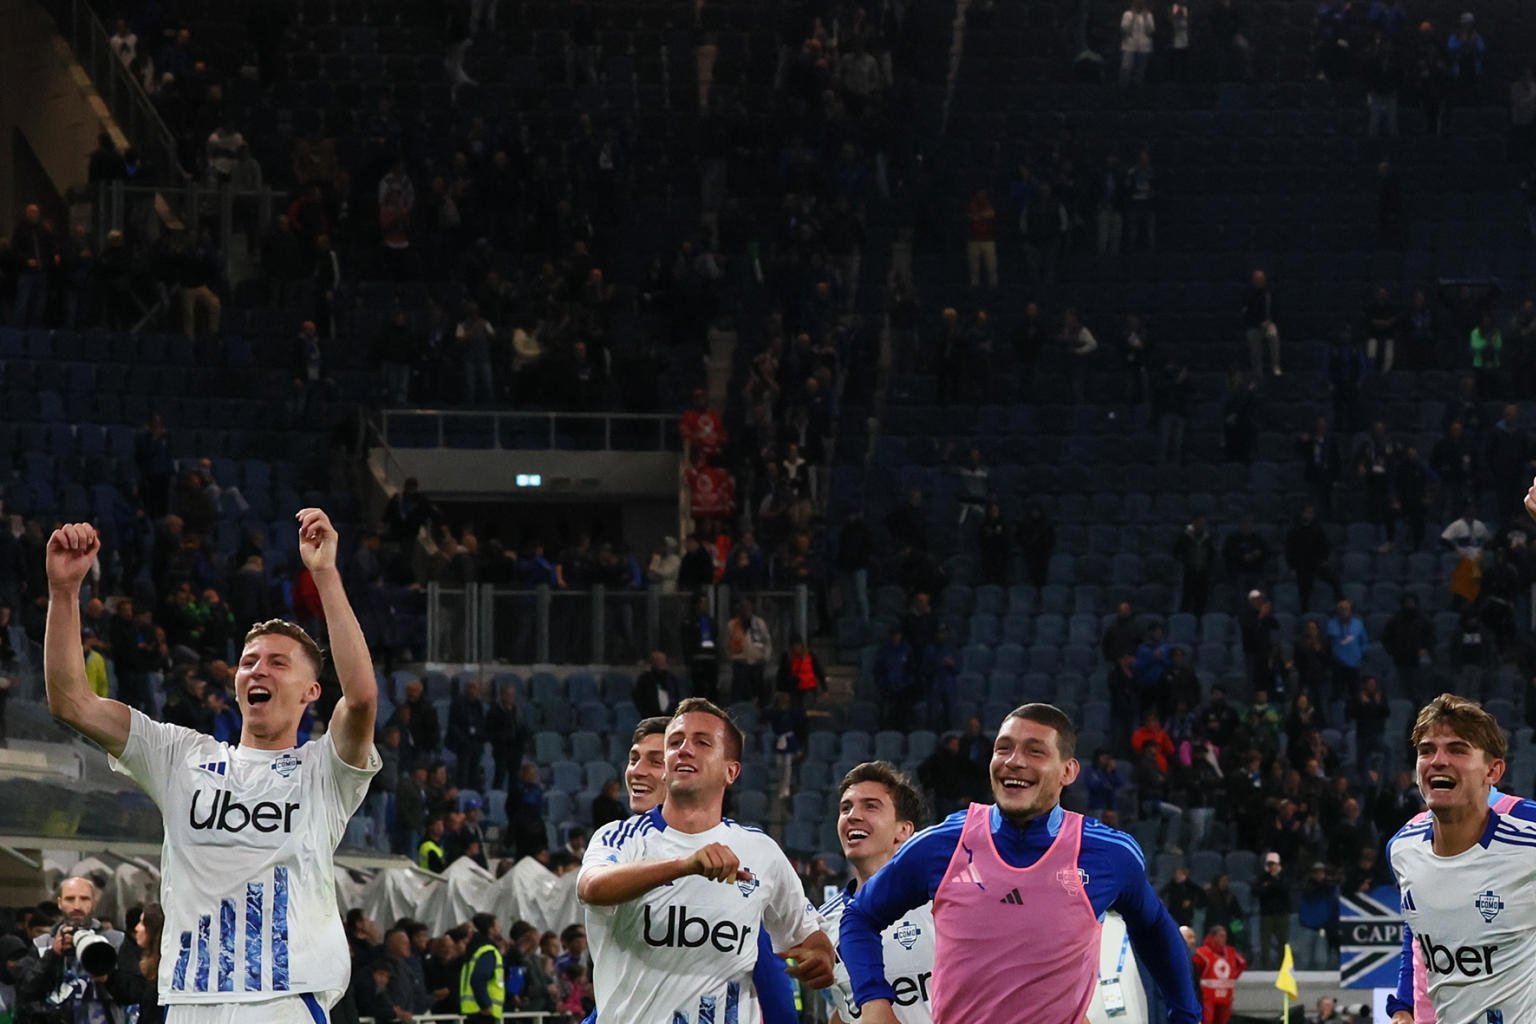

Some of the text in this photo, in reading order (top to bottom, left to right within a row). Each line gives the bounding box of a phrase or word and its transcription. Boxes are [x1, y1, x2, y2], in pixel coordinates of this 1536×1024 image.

[189, 789, 300, 833] Uber
[1480, 900, 1499, 910] COMO
[643, 904, 751, 955] Uber
[898, 928, 917, 939] COMO
